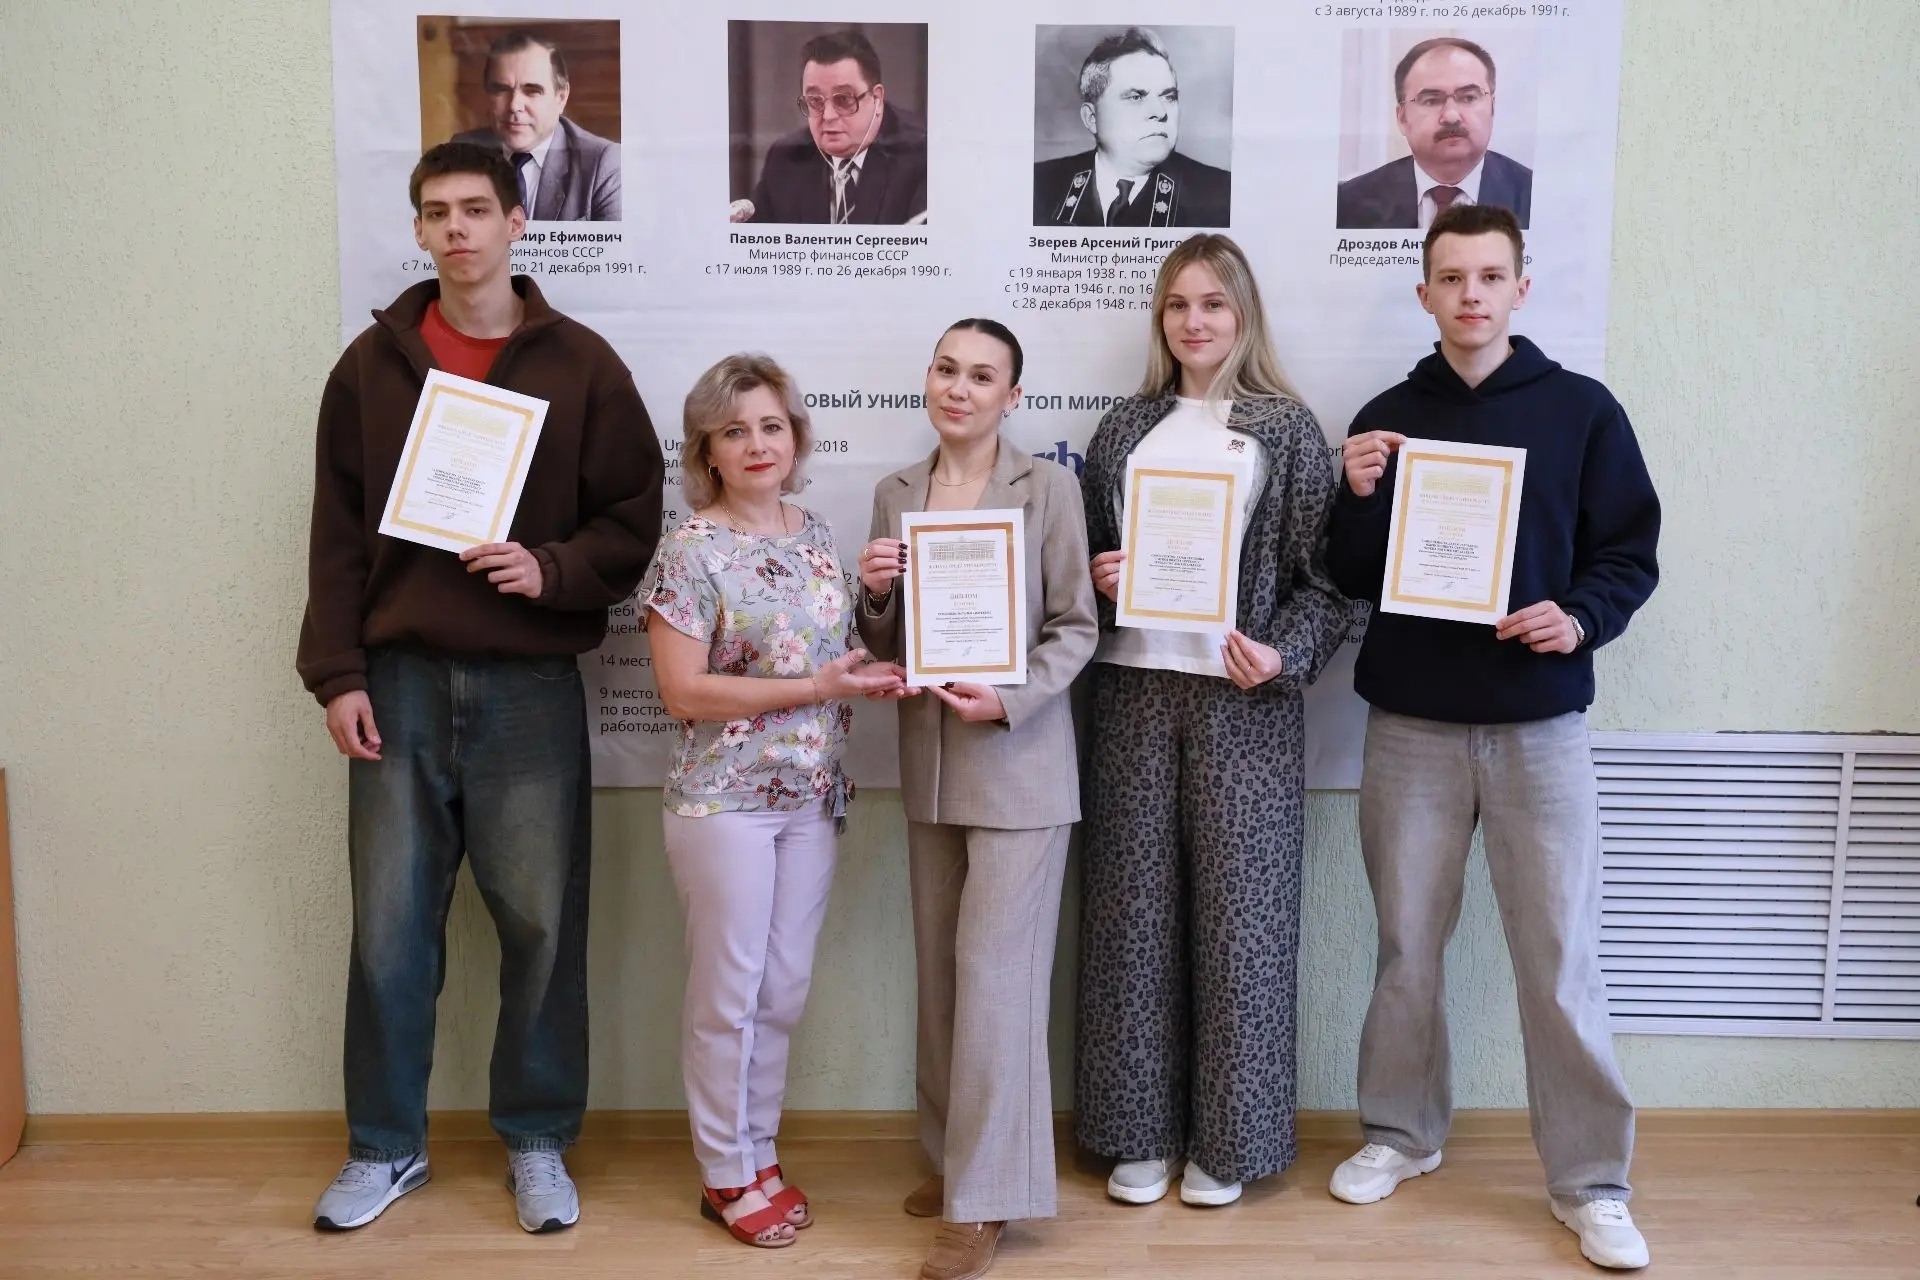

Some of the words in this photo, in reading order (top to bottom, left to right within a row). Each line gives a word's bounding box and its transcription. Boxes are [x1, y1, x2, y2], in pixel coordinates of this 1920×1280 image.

[1315, 7, 1321, 16] с
[1324, 5, 1332, 16] 3
[1335, 7, 1383, 19] августа
[1387, 5, 1417, 16] 1989
[1420, 8, 1428, 17] г.
[1433, 8, 1449, 16] по
[1453, 6, 1468, 16] 26
[1471, 5, 1526, 18] декабрь
[1531, 5, 1558, 16] 1991
[1562, 7, 1570, 17] г.
[550, 232, 622, 245] Ефимович
[730, 233, 781, 244] Павлов
[785, 234, 852, 245] Валентин
[855, 234, 928, 248] Сергеевич
[1028, 236, 1078, 250] Зверев
[1081, 237, 1141, 250] Арсений
[1144, 238, 1183, 251] Григо
[1337, 238, 1398, 252] Дроздов
[1401, 239, 1424, 250] Ант
[572, 247, 604, 258] СССР
[749, 249, 806, 263] Министр
[810, 249, 874, 263] финансов
[877, 250, 909, 261] СССР
[1051, 252, 1108, 266] Министр
[1111, 252, 1167, 266] финансо
[1329, 254, 1420, 266] Председатель
[402, 262, 409, 271] с
[412, 260, 419, 271] 7
[511, 262, 527, 273] по
[530, 261, 543, 273] 21
[548, 261, 601, 276] декабря
[605, 263, 634, 274] 1991
[638, 264, 647, 274] г.
[705, 266, 711, 275] с
[716, 264, 730, 275] 17
[734, 265, 768, 275] июля
[772, 264, 802, 276] 1989
[805, 267, 813, 276] г.
[817, 267, 833, 276] по
[836, 265, 852, 276] 26
[854, 264, 907, 279] декабря
[911, 265, 940, 276] 1990
[944, 267, 952, 277] г.
[1009, 269, 1015, 278] с
[1019, 267, 1033, 278] 19
[1036, 269, 1082, 282] января
[1086, 268, 1116, 279] 1938
[1119, 270, 1127, 280] г.
[1131, 270, 1147, 280] по
[1004, 284, 1011, 293] с
[1015, 282, 1029, 293] 19
[1032, 285, 1070, 296] марта
[1074, 283, 1103, 294] 1946
[1107, 286, 1115, 295] г.
[1119, 286, 1135, 295] по
[1139, 284, 1153, 295] 16
[1012, 300, 1019, 309] с
[1022, 298, 1037, 309] 28
[1039, 298, 1092, 312] декабря
[1096, 299, 1125, 309] 1948
[1128, 301, 1137, 310] г.
[804, 389, 862, 408] ОВЫЙ
[867, 393, 928, 409] УНИВ
[1024, 395, 1062, 410] ТОП
[814, 440, 848, 453] 2018
[600, 655, 615, 666] 14
[600, 687, 608, 699] 9
[612, 689, 654, 699] место
[600, 706, 618, 716] по
[622, 706, 669, 719] востре
